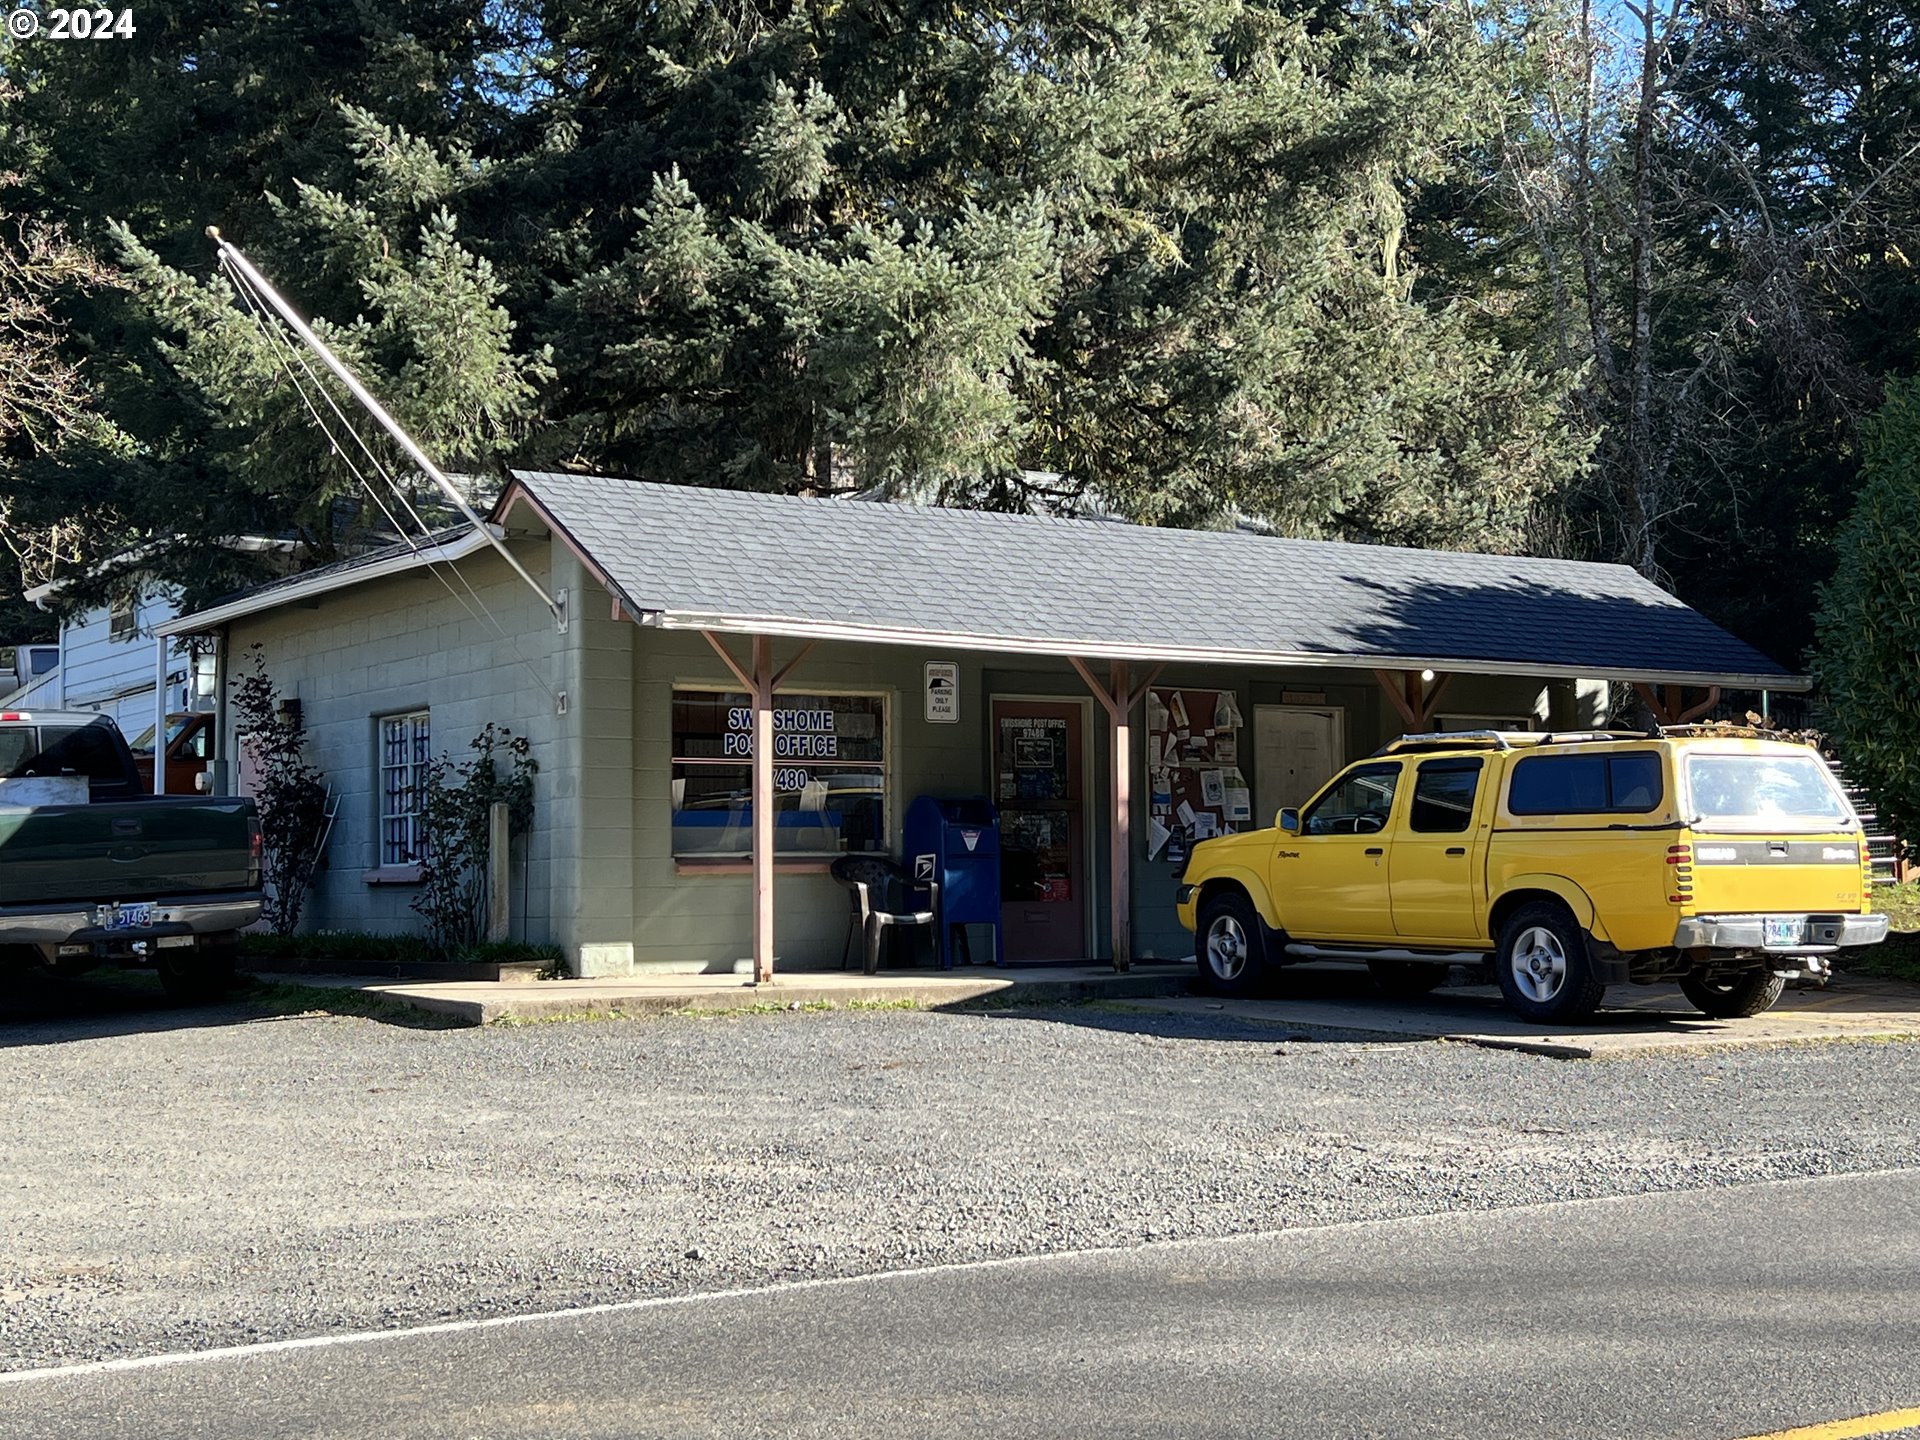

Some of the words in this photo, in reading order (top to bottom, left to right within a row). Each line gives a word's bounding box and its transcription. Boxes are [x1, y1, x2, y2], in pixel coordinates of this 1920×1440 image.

[930, 688, 953, 696] PARKING
[932, 705, 951, 713] PLEASE
[728, 707, 834, 731] SWSHOME
[1033, 718, 1047, 728] POST
[1048, 719, 1067, 729] OFFICE
[1022, 728, 1045, 738] 97480
[724, 733, 754, 755] PO
[775, 734, 837, 756] OFFICE
[119, 909, 150, 924] 51465
